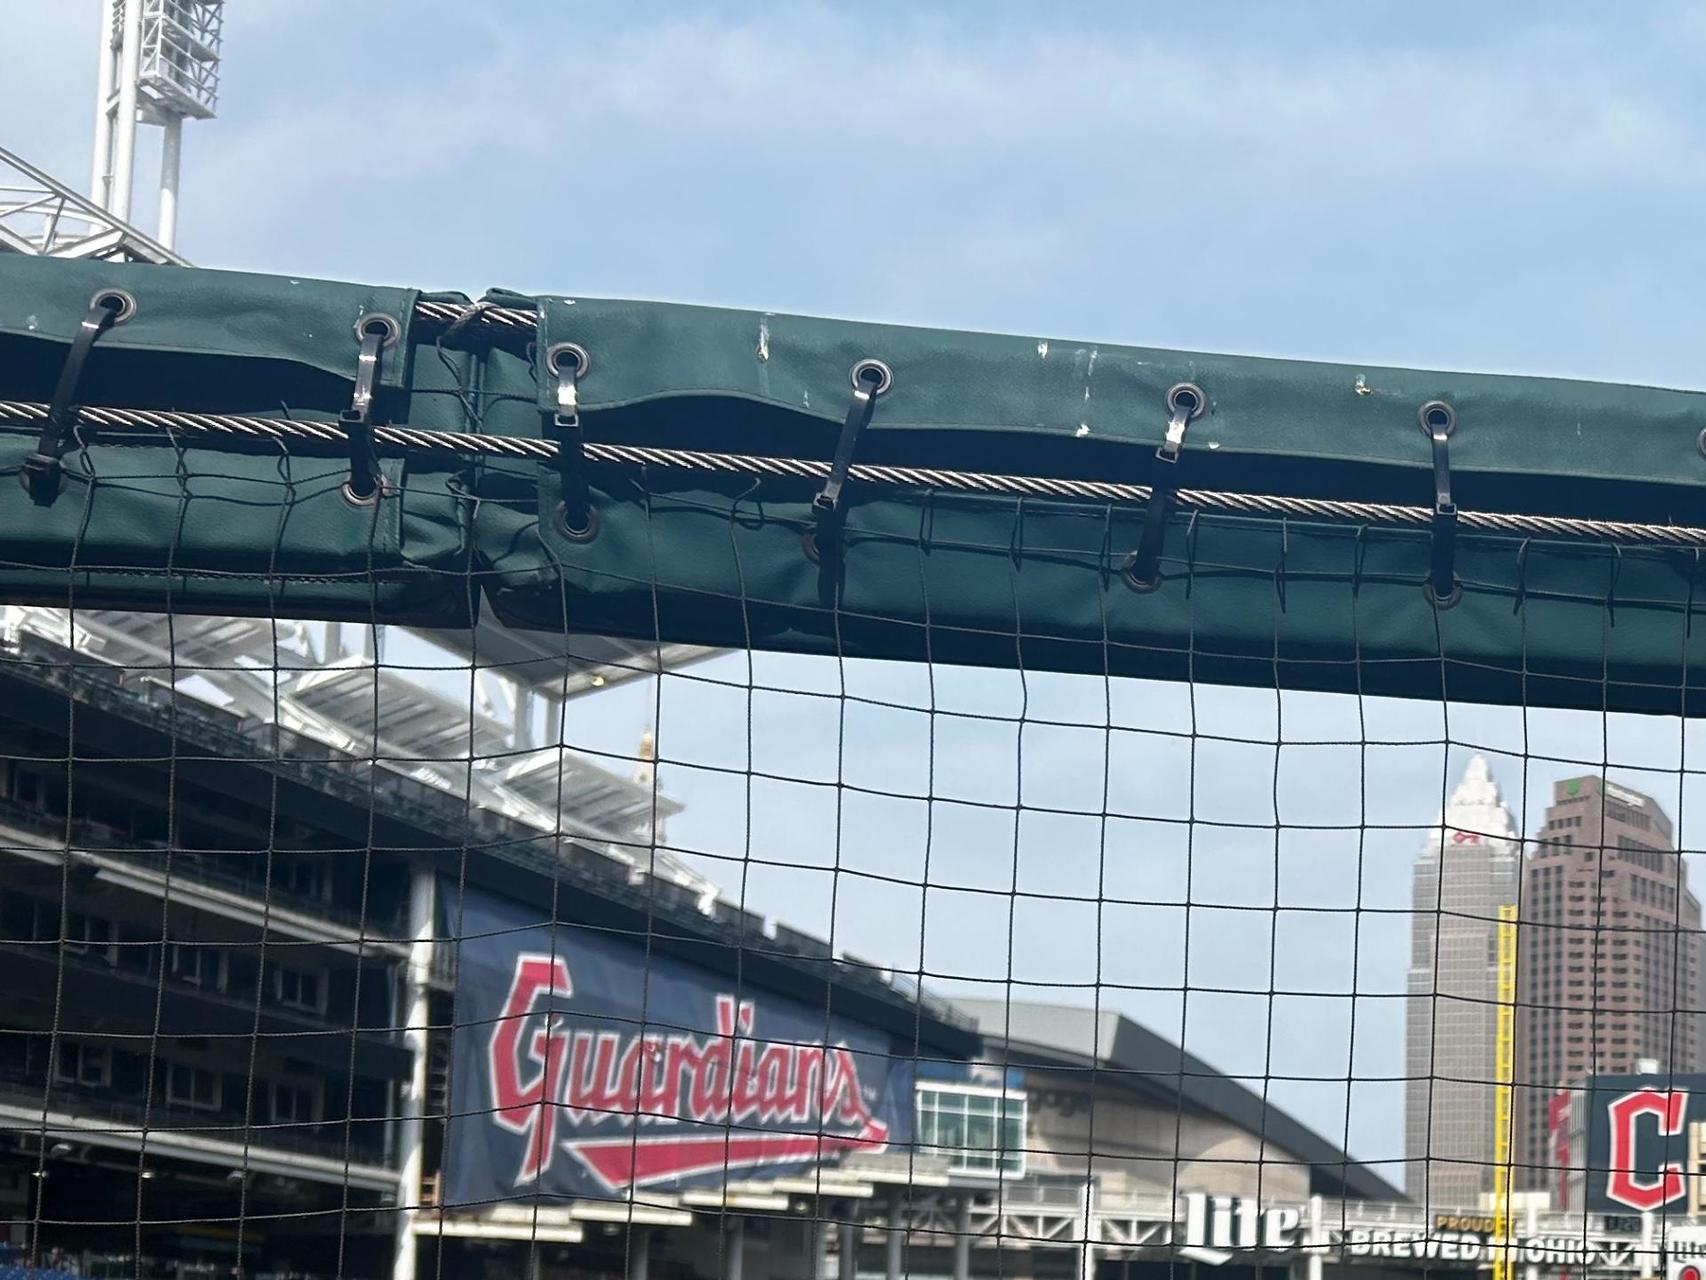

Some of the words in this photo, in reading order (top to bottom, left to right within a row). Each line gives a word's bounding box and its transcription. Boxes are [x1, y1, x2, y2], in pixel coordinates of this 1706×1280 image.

[489, 952, 872, 1187] Guardians
[1606, 1086, 1689, 1212] C
[1179, 1193, 1301, 1266] Lite
[1350, 1230, 1480, 1261] BREWED
[1527, 1239, 1596, 1265] OHIO
